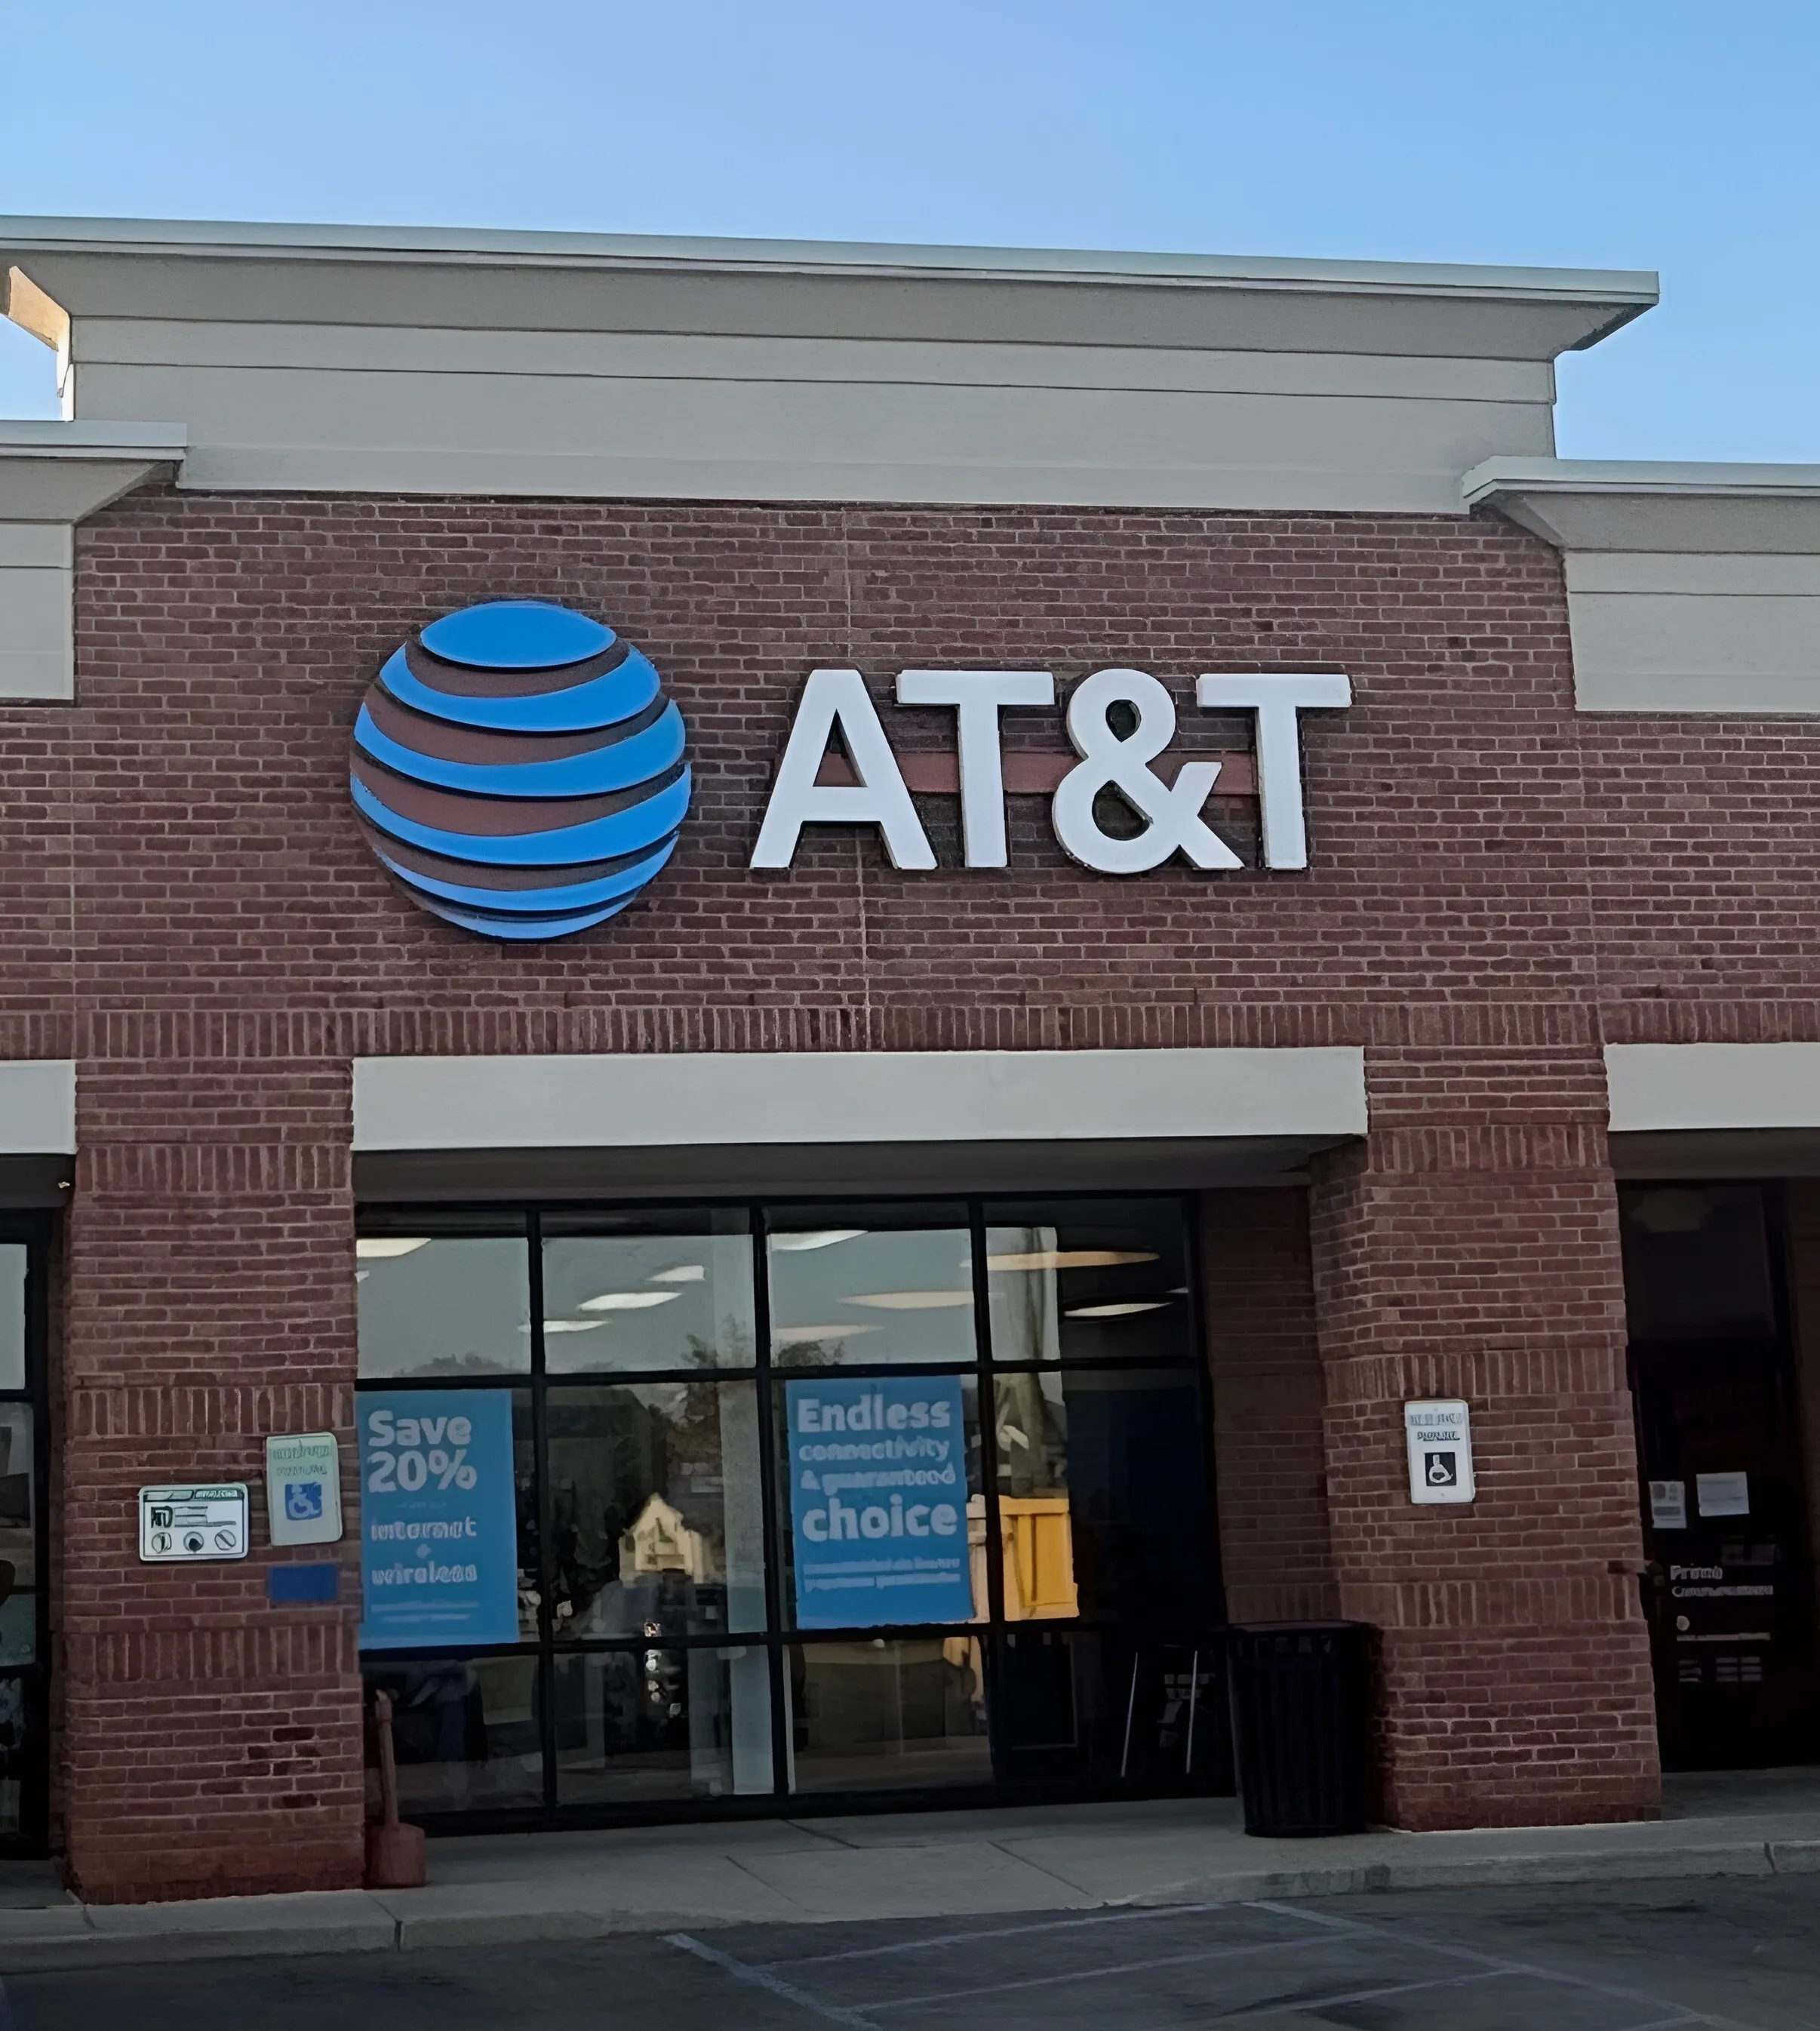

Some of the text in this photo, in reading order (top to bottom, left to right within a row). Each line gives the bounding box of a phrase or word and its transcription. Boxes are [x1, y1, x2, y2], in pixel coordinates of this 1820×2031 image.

[749, 669, 1352, 873] AT&T
[368, 1410, 471, 1447] Save
[798, 1394, 950, 1432] Endless
[367, 1448, 477, 1493] 20%
[803, 1494, 957, 1541] choice
